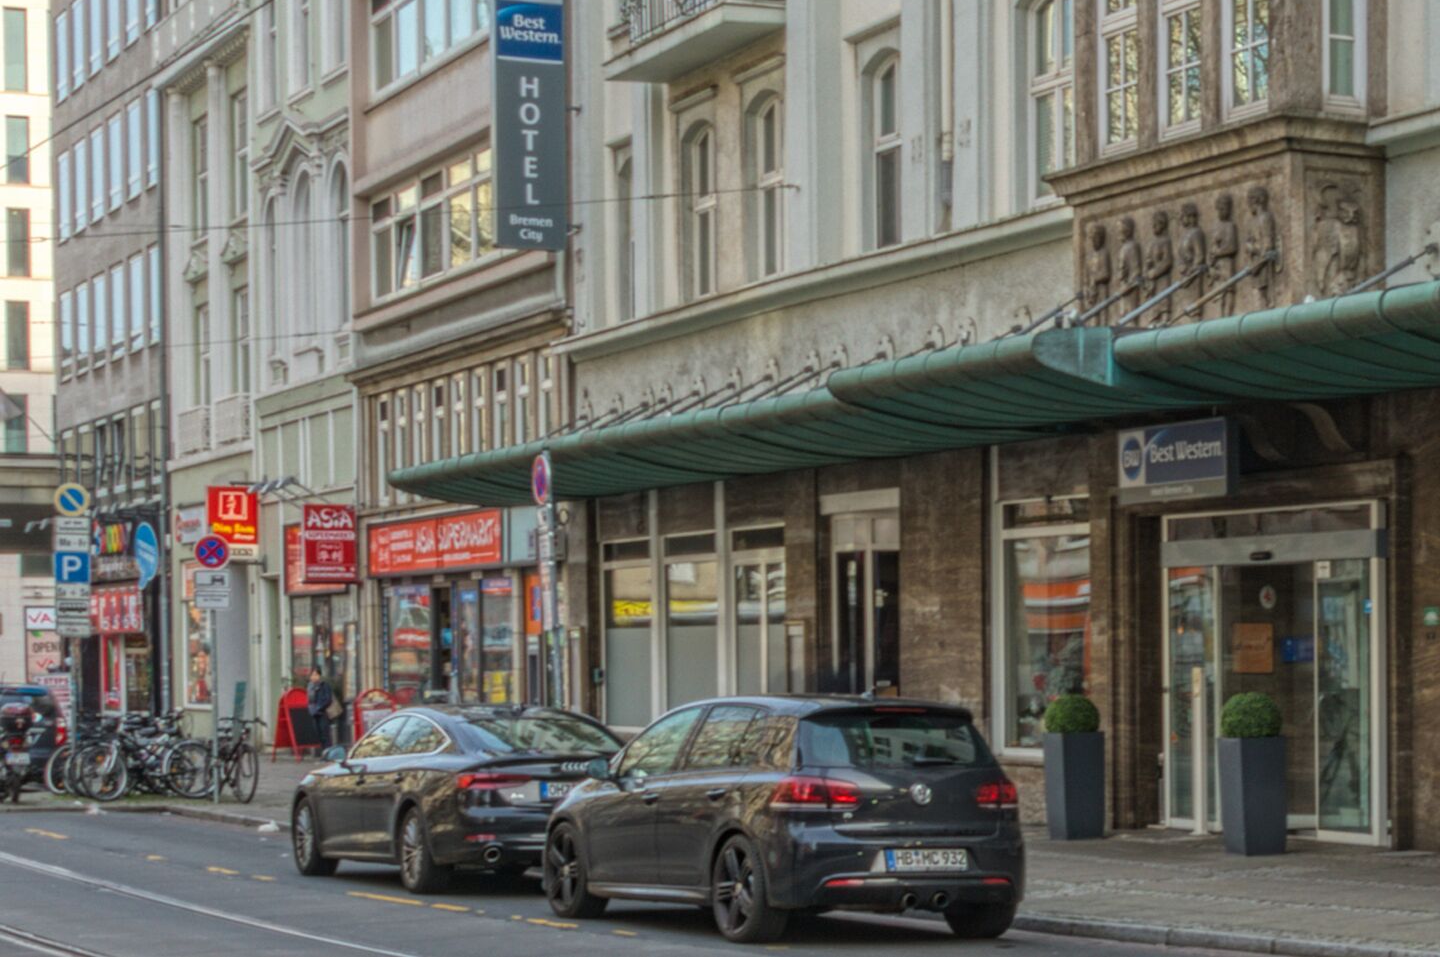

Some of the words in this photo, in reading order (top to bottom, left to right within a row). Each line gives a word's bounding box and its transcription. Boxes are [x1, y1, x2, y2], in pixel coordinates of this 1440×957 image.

[512, 13, 546, 30] Best
[519, 76, 541, 205] HOTEL
[509, 213, 553, 228] Bremen
[519, 228, 544, 243] City
[1150, 443, 1175, 463] Best
[62, 555, 82, 581] P
[896, 851, 914, 866] HB
[922, 851, 940, 866] MC
[942, 851, 967, 865] 932
